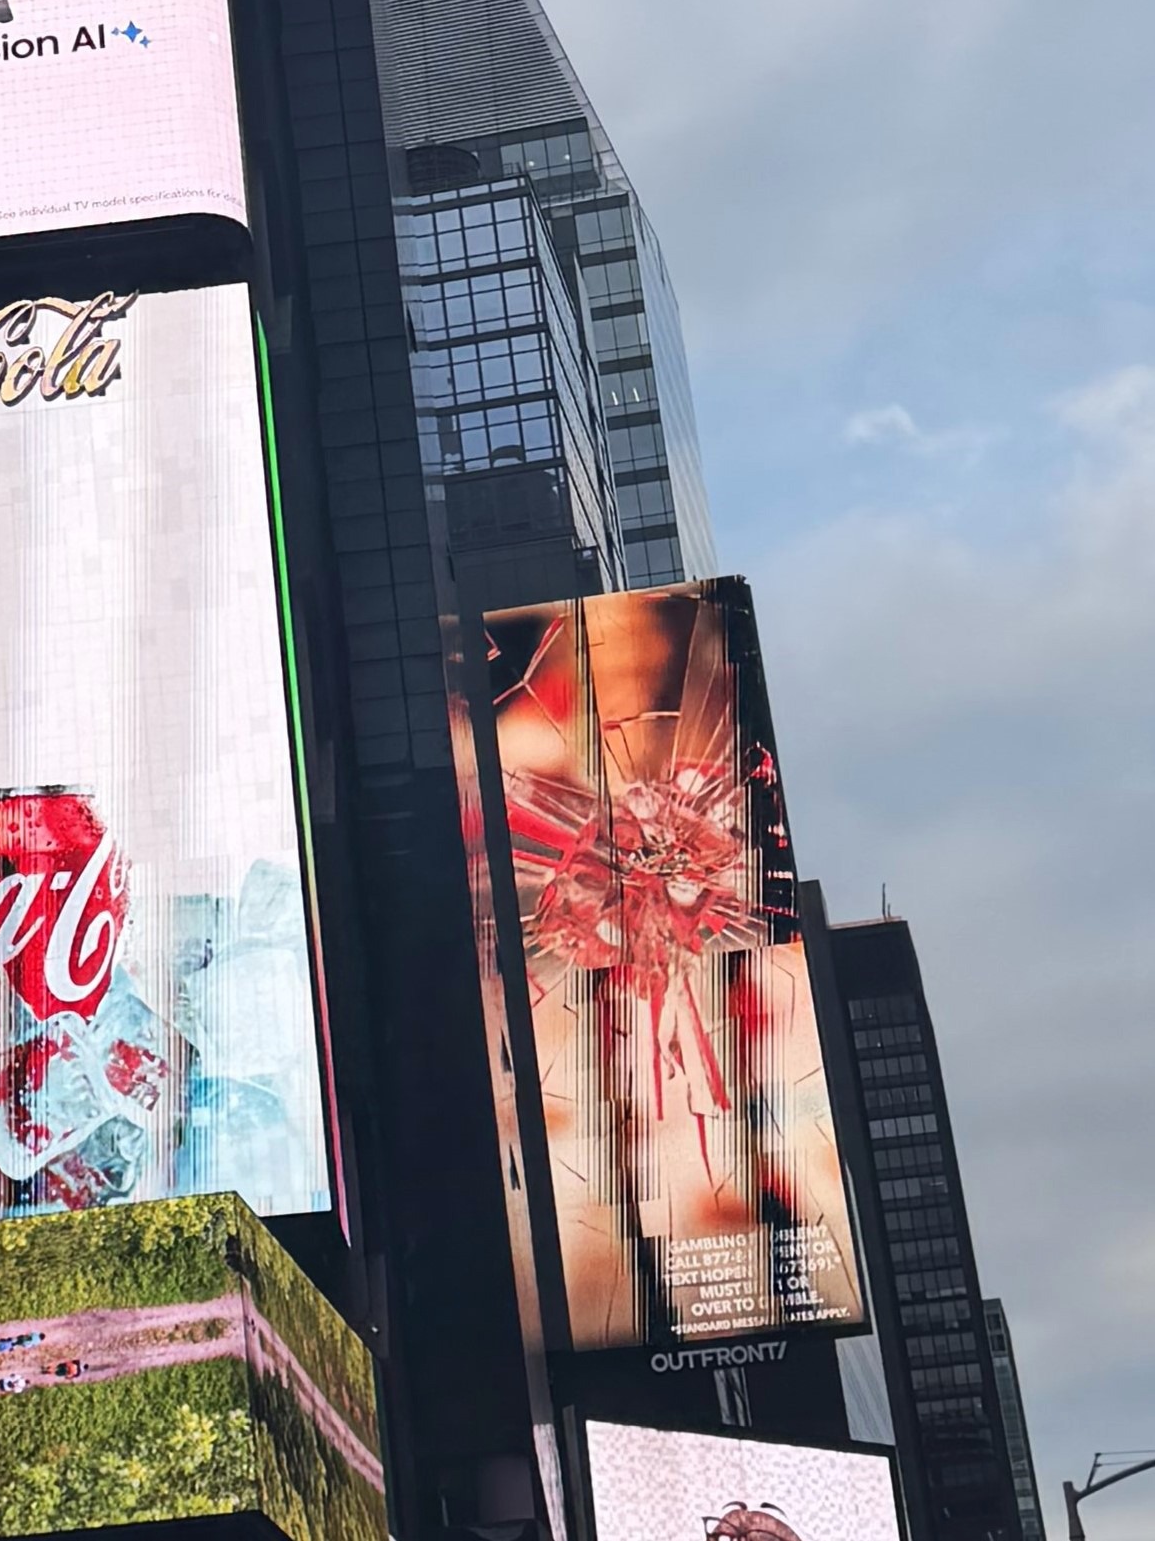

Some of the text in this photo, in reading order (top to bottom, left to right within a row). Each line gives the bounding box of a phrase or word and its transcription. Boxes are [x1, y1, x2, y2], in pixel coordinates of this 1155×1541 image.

[72, 23, 106, 54] AI
[665, 1254, 702, 1272] CALL
[812, 1240, 837, 1256] OR
[670, 1234, 747, 1255] GAMBLING
[663, 1271, 700, 1287] TEXT
[700, 1282, 742, 1299] MUST
[787, 1274, 811, 1291] OR
[691, 1299, 732, 1317] OVER
[733, 1297, 755, 1312] TO
